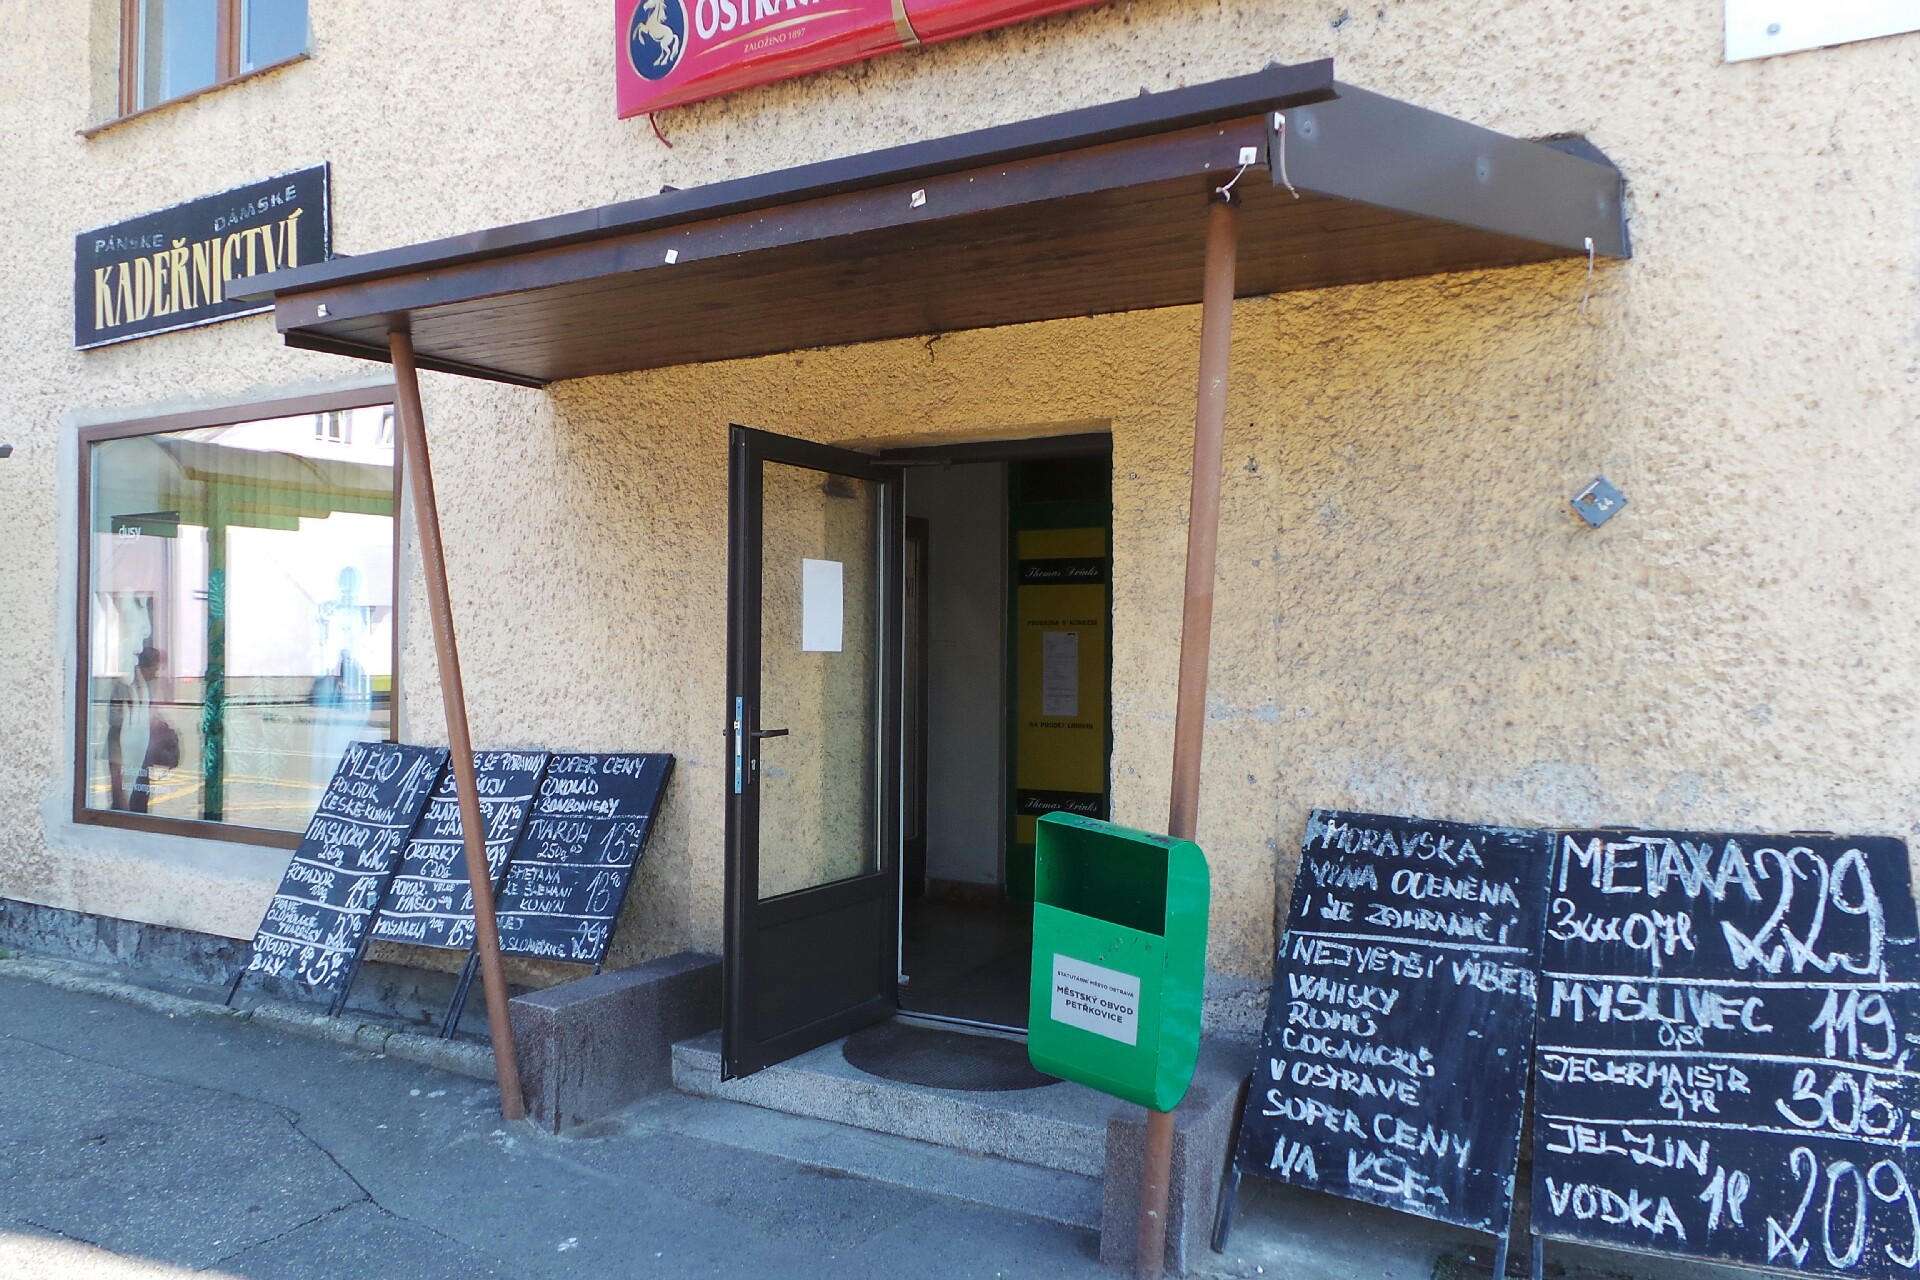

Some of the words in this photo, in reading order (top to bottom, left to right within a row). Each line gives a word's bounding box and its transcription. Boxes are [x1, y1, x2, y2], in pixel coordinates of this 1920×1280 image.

[743, 34, 787, 53] ZALOŽENO
[788, 27, 806, 43] 1897
[94, 207, 304, 331] KADEŘNICTVÍ
[1025, 567, 1061, 578] Thomas
[1065, 566, 1099, 576] Drinks
[1025, 797, 1061, 809] Thomas
[1065, 799, 1098, 812] Drinks
[1057, 970, 1089, 984] STATUTÁRNÍ
[1089, 980, 1108, 990] MĚSTO
[1109, 986, 1134, 998] OSTRAVA
[1056, 984, 1098, 1004] MĚSTSKÝ
[1099, 999, 1134, 1015] OBVOD
[1065, 998, 1123, 1024] PETŘKOVICE
[1550, 979, 1774, 1034] MYSLIVEC
[1545, 1176, 1687, 1240] VODKA
